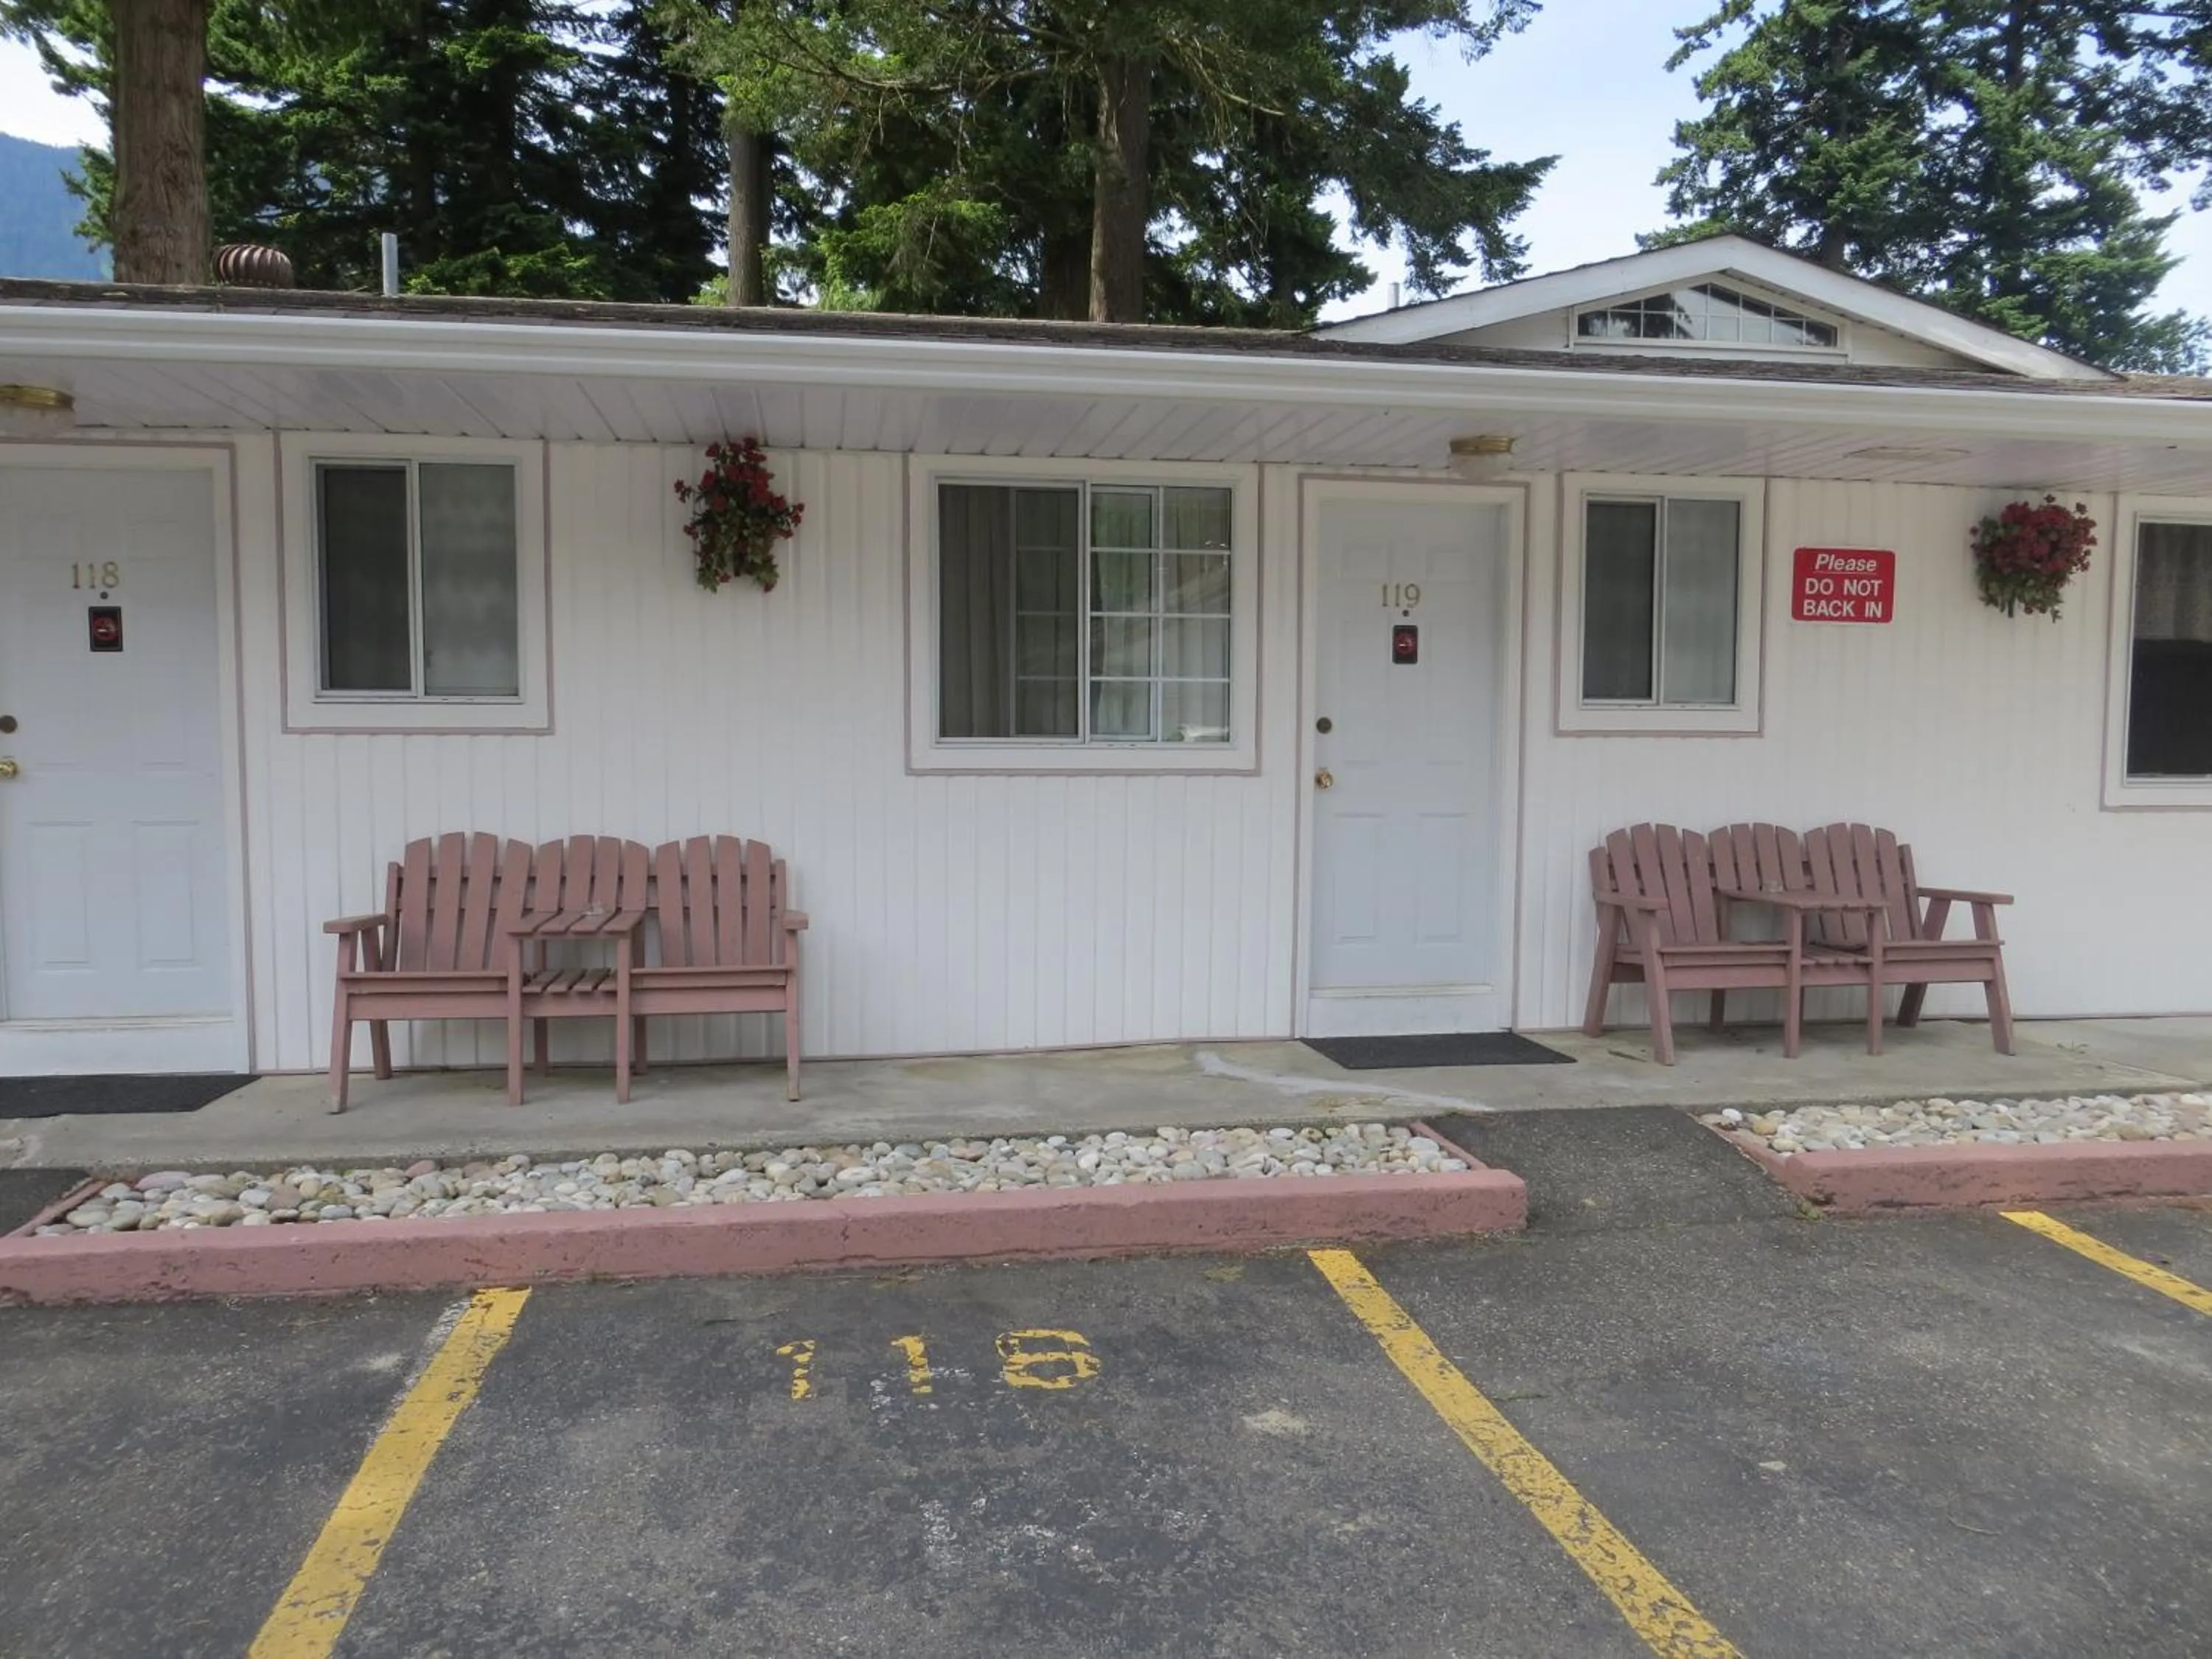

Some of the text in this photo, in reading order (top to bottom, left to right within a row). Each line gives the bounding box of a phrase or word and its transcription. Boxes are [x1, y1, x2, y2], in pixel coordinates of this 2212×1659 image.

[1815, 554, 1877, 571] Please
[72, 561, 119, 589] 118
[1382, 582, 1421, 608] 119
[1805, 577, 1882, 597] DO NOT
[1803, 599, 1882, 618] BACK IN
